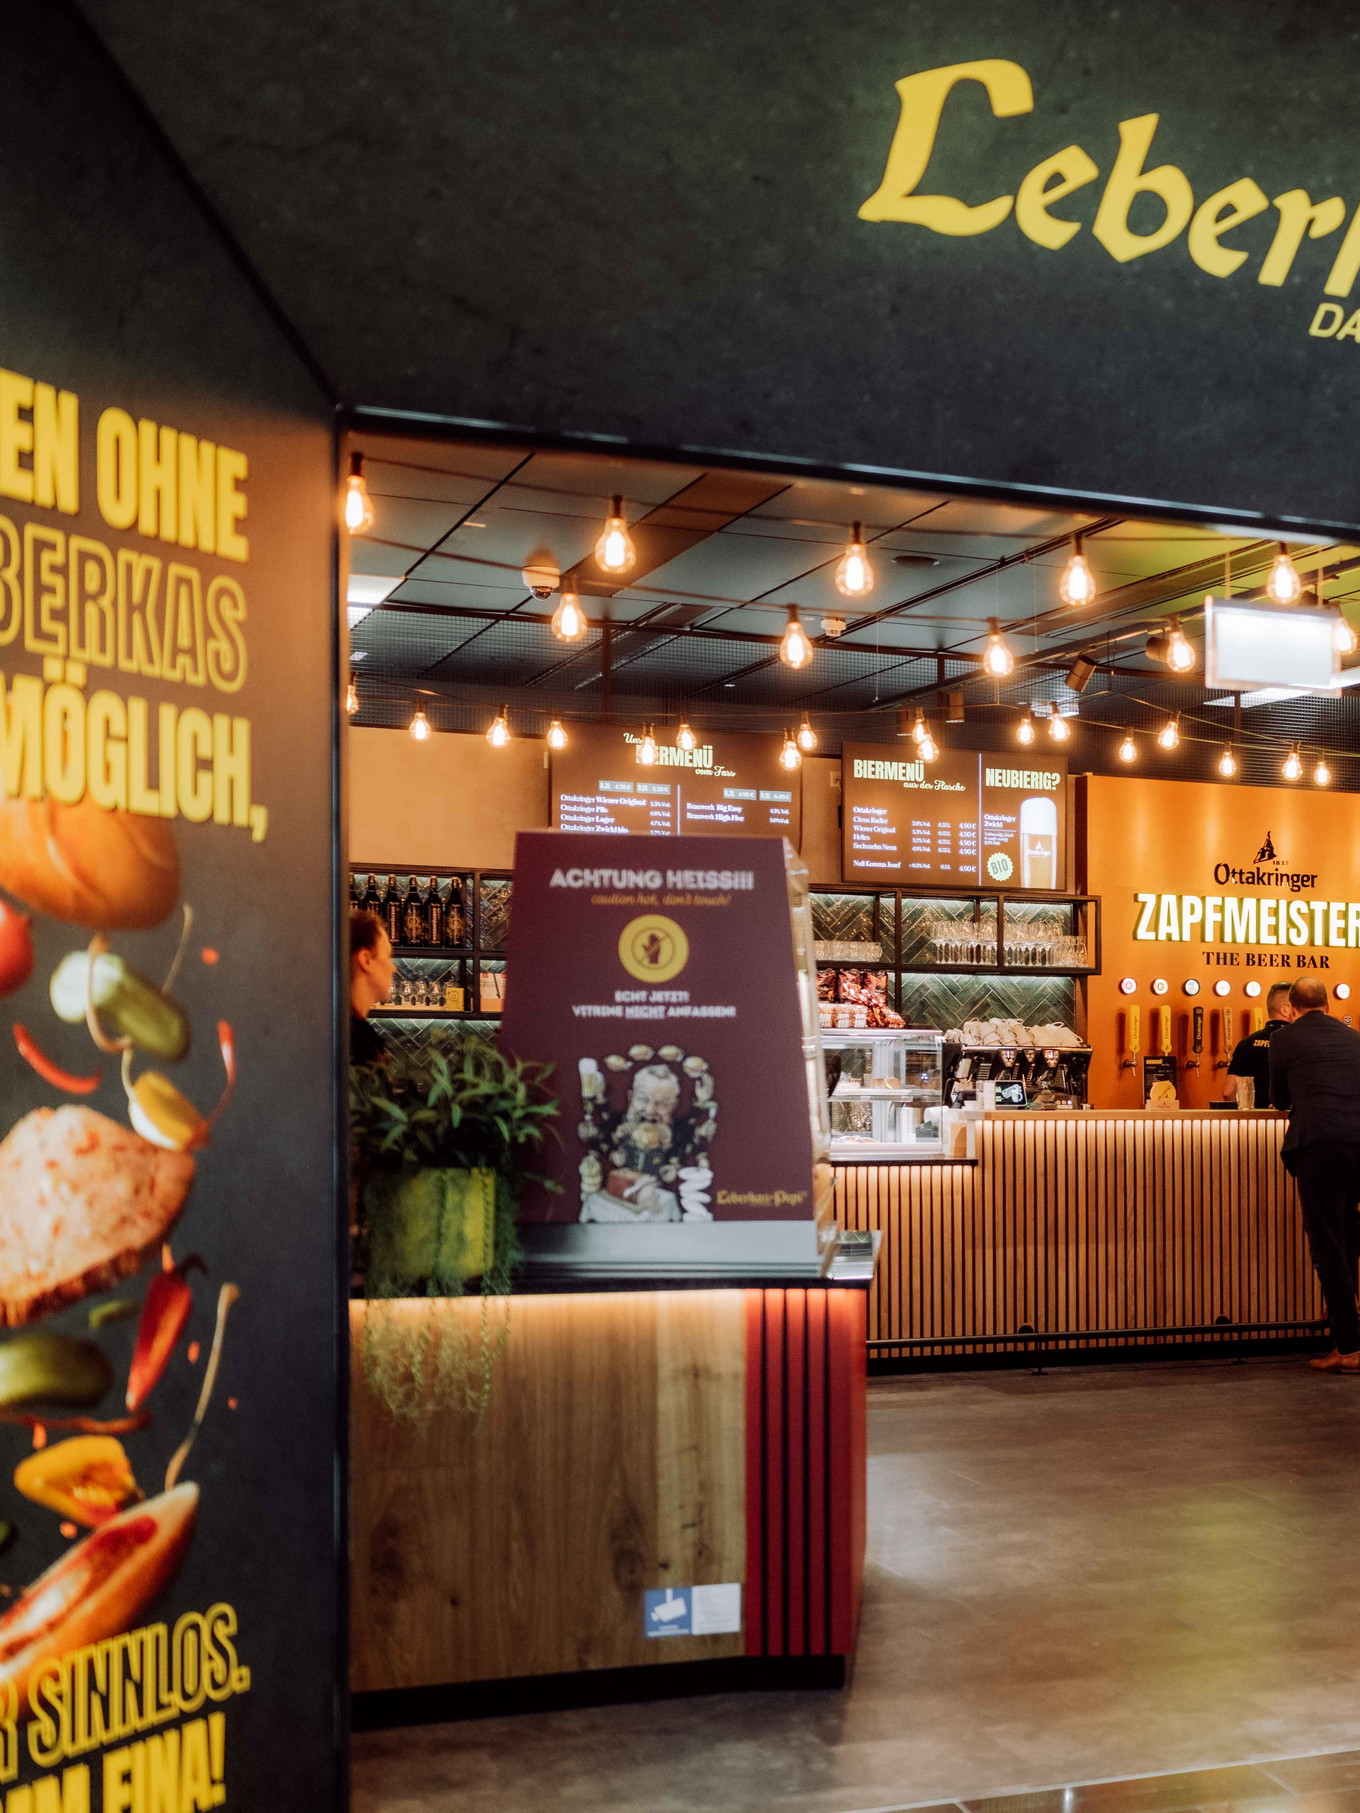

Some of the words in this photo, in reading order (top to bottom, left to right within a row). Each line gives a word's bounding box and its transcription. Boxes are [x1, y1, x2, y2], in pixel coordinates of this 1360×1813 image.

[96, 406, 248, 562] OHNE
[854, 759, 924, 782] BIERMENÜ
[986, 768, 1060, 790] NEUBIERIG?
[934, 780, 966, 792] Flasche
[560, 794, 595, 804] Ottakringer
[596, 796, 620, 804] Wiener
[620, 797, 646, 806] Original
[560, 804, 595, 814] Ottakringer
[716, 804, 728, 813] Big
[853, 806, 888, 815] Ottakringer
[560, 814, 595, 823] Ottakringer
[596, 815, 615, 824] Lager
[716, 813, 731, 822] High
[731, 814, 745, 822] Five
[984, 814, 1016, 823] Ottakringer
[560, 824, 595, 833] Ottakringer
[874, 826, 896, 834] Original
[990, 858, 1009, 875] BIO
[550, 868, 663, 889] ACHTUNG
[1214, 862, 1318, 892] Ottakringer
[1202, 952, 1240, 966] THE
[1246, 952, 1290, 967] BEER
[1296, 954, 1330, 968] BAR
[27, 1602, 251, 1768] SINNLOS.
